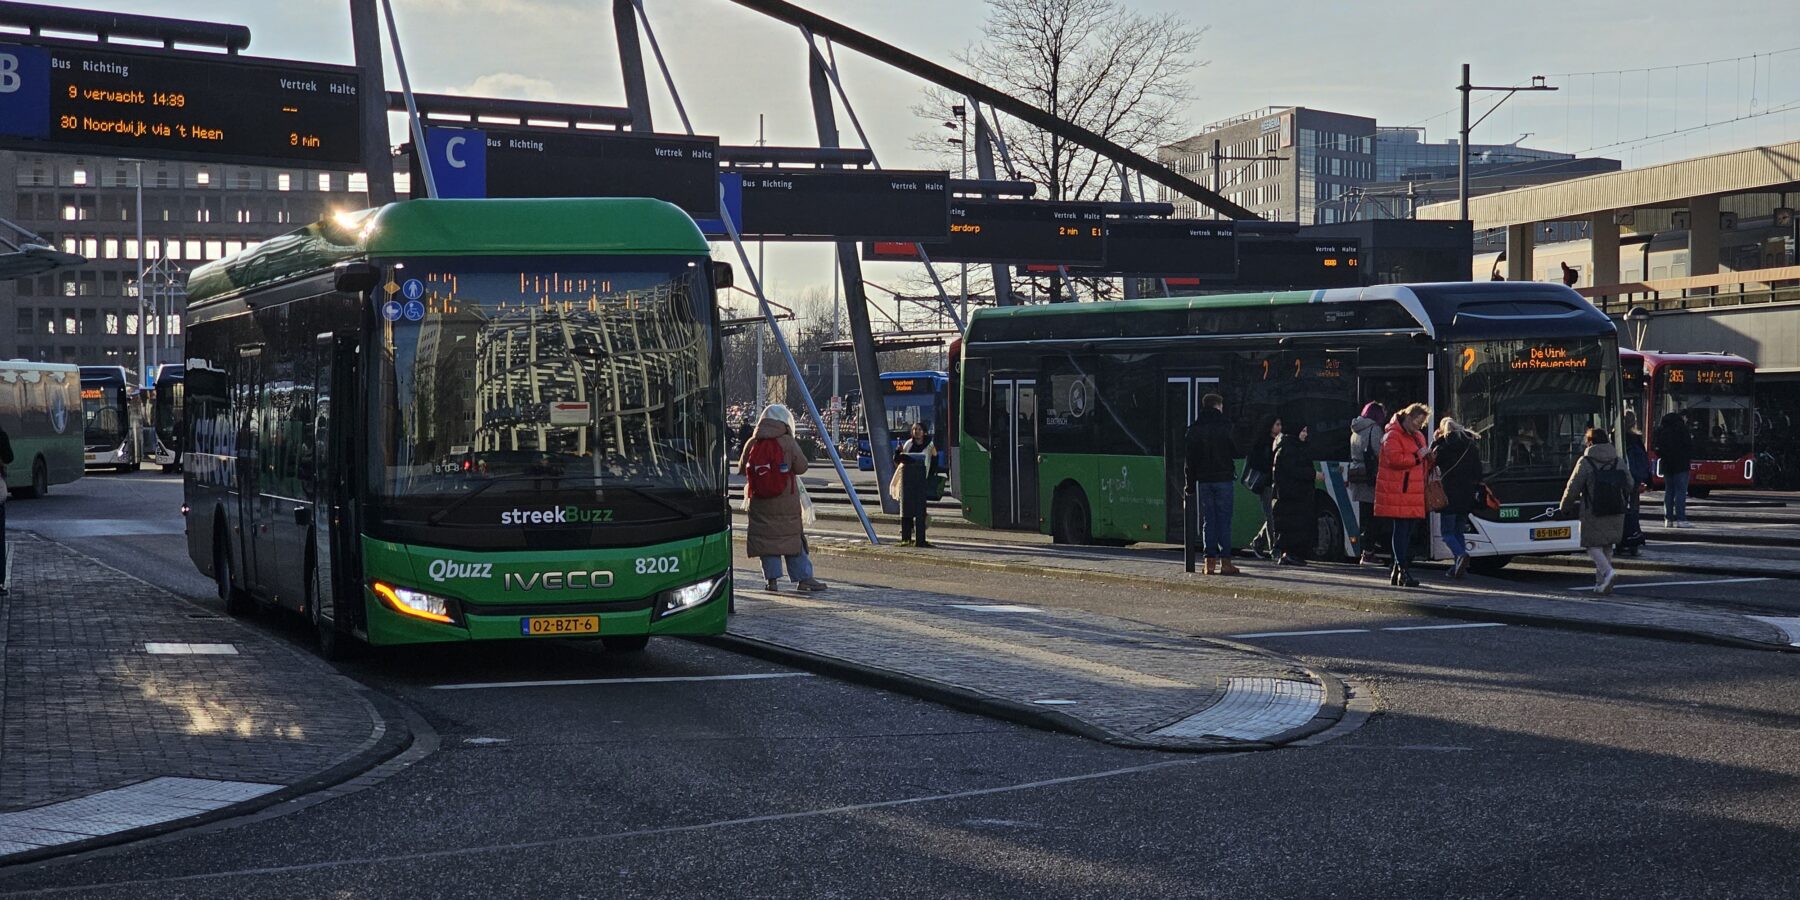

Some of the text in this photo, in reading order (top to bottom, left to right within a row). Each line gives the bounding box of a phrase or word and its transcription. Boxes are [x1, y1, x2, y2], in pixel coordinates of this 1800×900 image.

[0, 53, 21, 93] B
[52, 58, 129, 77] Bus Richting
[280, 78, 356, 95] Vertrek Halte
[68, 85, 185, 107] 9 verwacht 14:39
[61, 115, 77, 129] 30
[84, 117, 147, 137] Noordwijk
[152, 125, 171, 136] via
[192, 126, 223, 140] Heen
[290, 133, 320, 147] 3 min
[487, 138, 544, 151] Bus Richting
[446, 136, 466, 168] C
[655, 148, 712, 159] Vertrek Halte
[762, 180, 793, 190] Richting
[891, 182, 944, 191] Vertrek Halte
[1054, 211, 1077, 219] Vertrek
[1190, 229, 1211, 237] Vertrek
[1531, 348, 1543, 358] De
[1545, 347, 1566, 358] Vink
[501, 505, 614, 524] streekBuzz
[1500, 509, 1518, 518] 8110
[428, 560, 493, 582] Qbuzz
[635, 556, 680, 575] 8202
[504, 569, 615, 592] IVECO
[533, 619, 592, 632] 02-BZT-6
